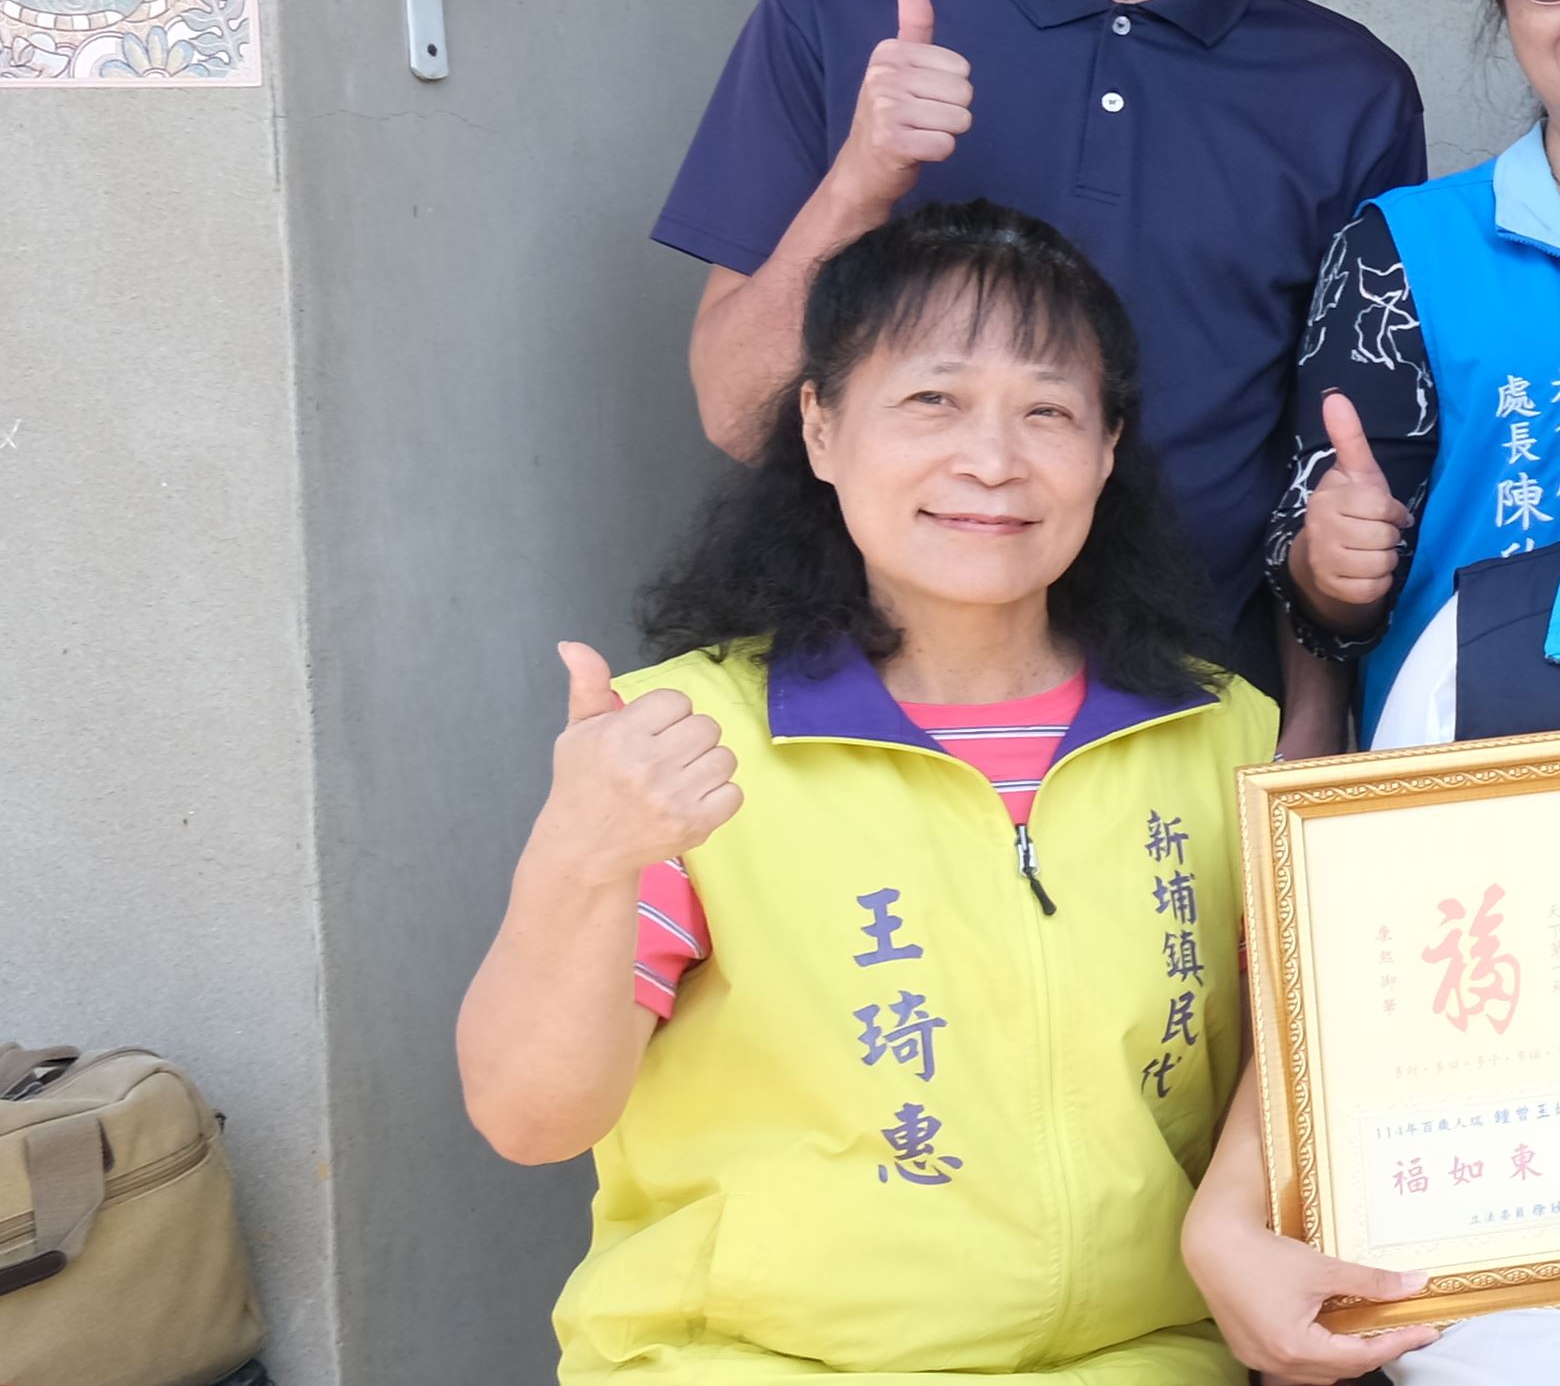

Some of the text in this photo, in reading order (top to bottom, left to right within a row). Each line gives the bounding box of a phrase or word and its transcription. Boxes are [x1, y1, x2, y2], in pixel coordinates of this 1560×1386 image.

[852, 887, 964, 1186] 王琦惠
[1140, 808, 1205, 1100] 新埔鎮民代
[1420, 883, 1522, 1035] 福
